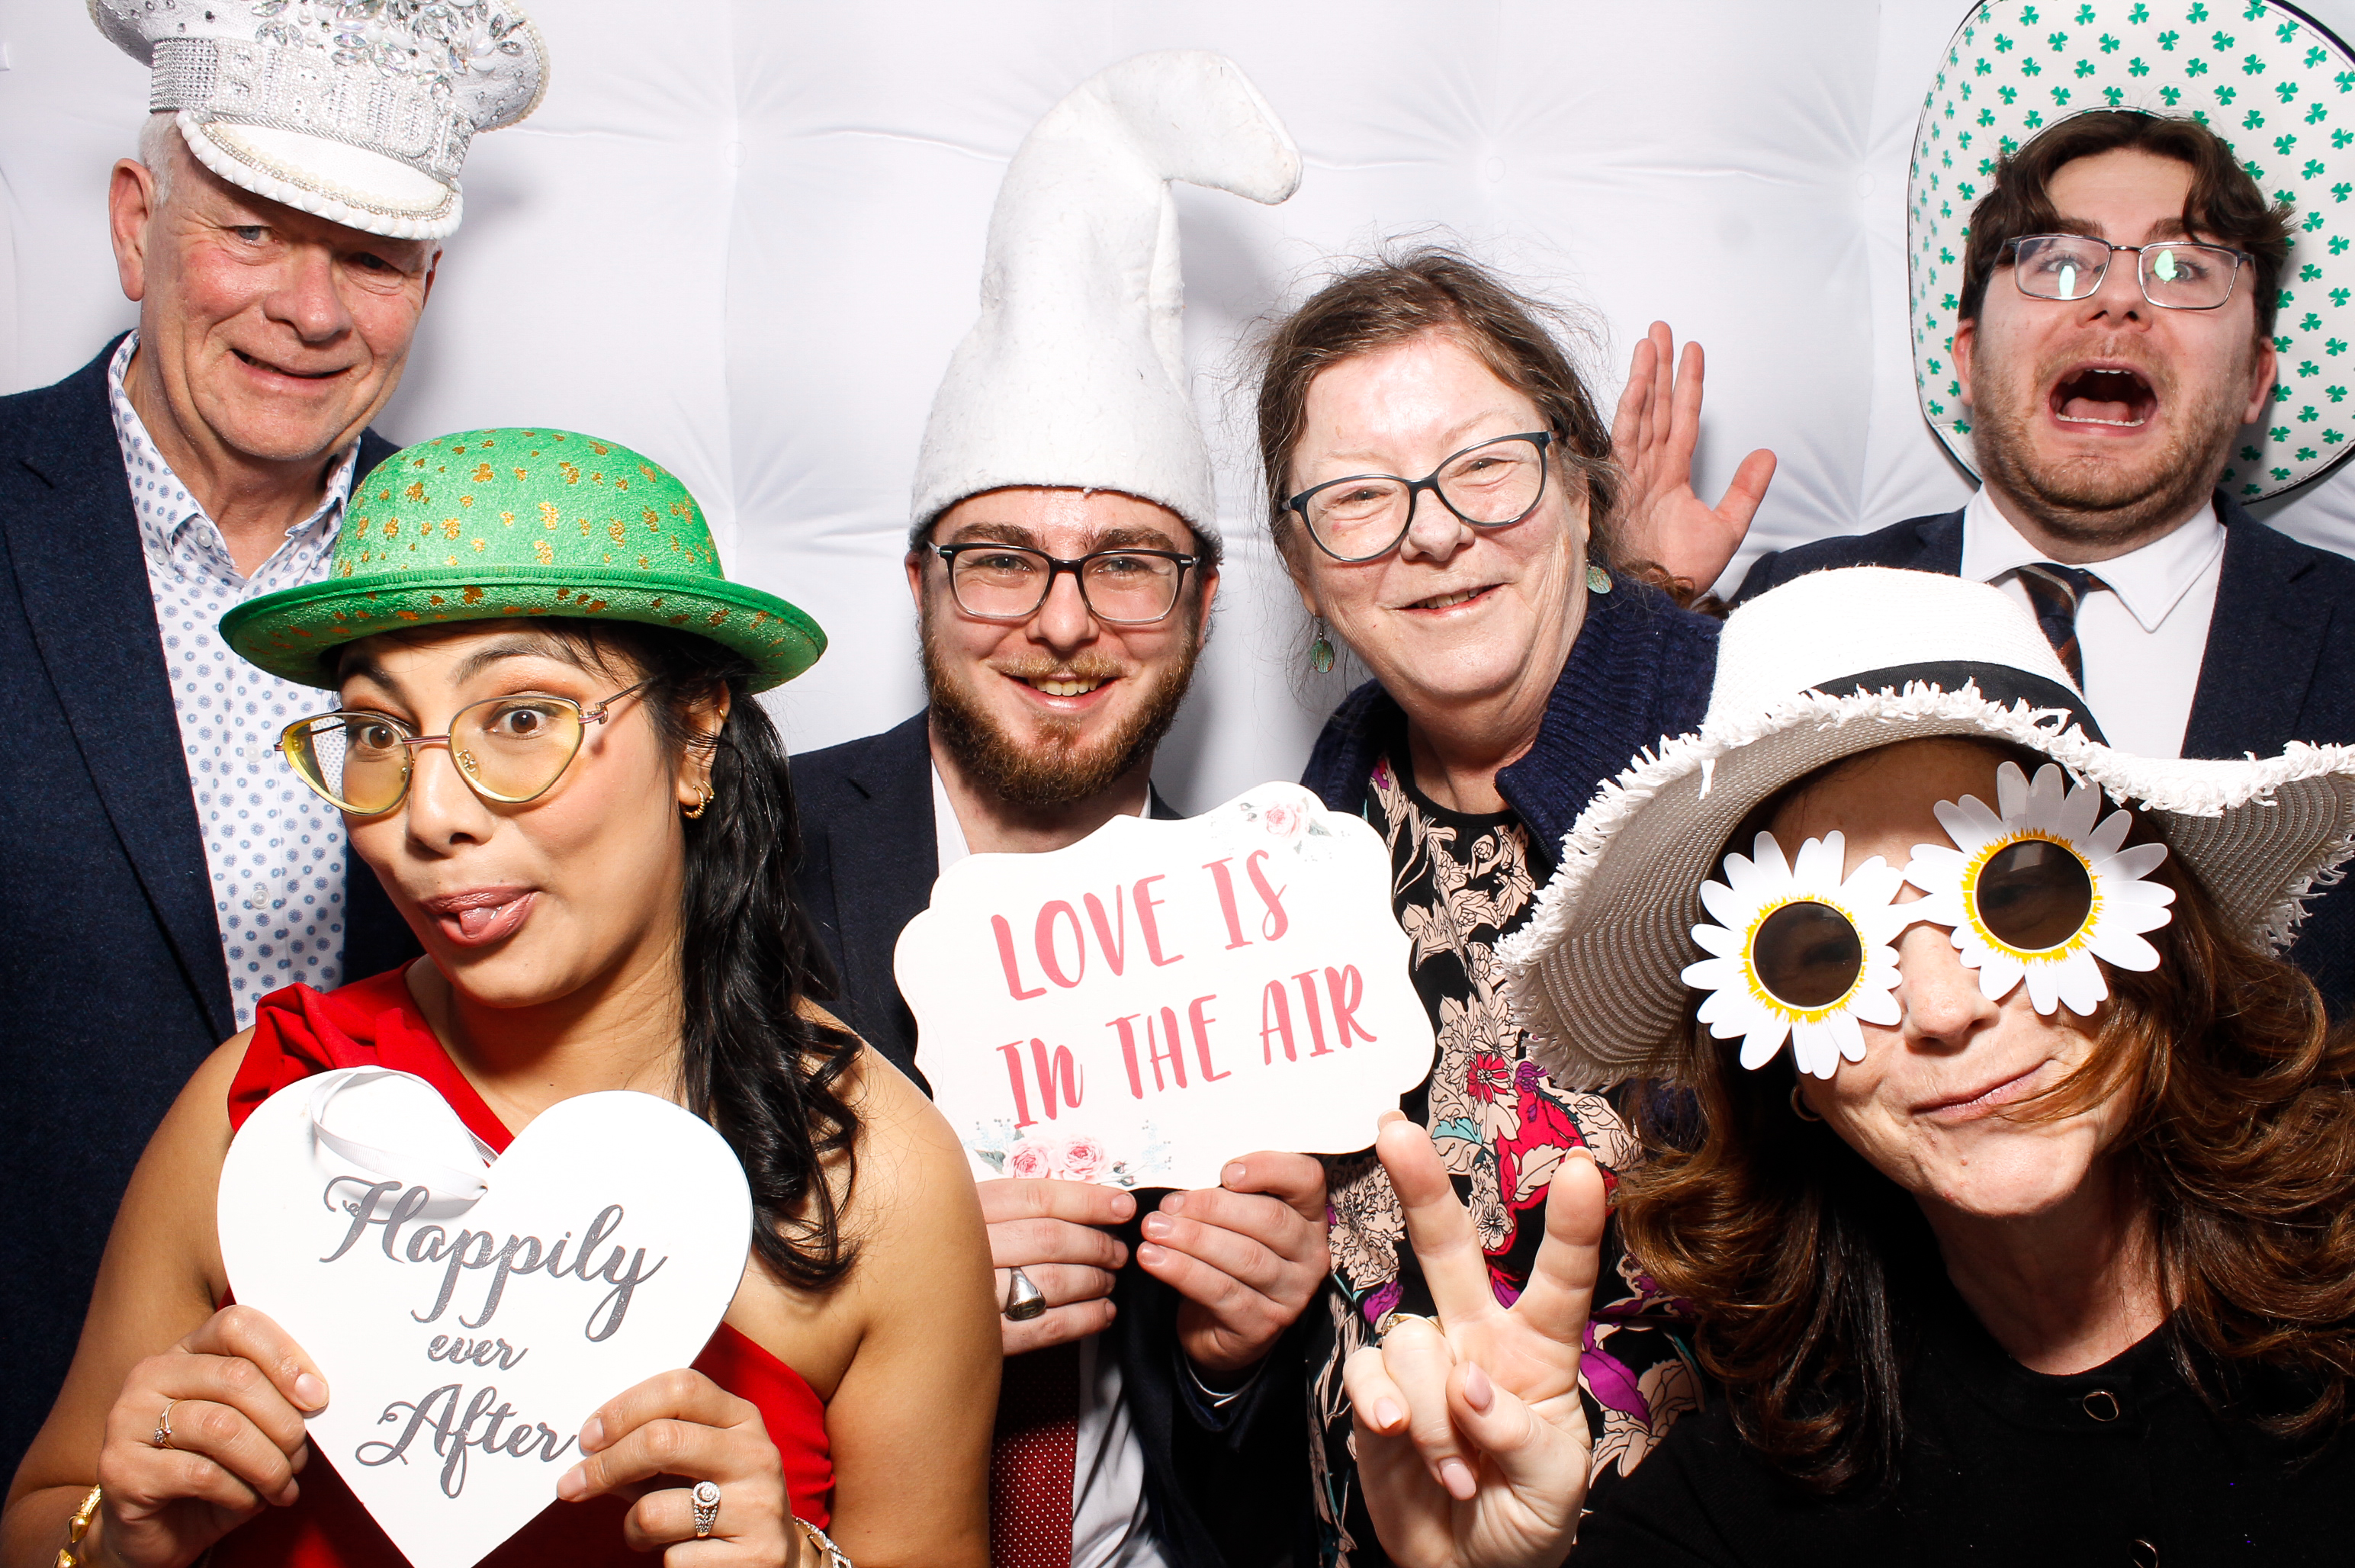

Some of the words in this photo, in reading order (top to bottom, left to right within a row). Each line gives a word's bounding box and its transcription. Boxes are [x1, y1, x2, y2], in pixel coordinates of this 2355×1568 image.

[210, 37, 474, 175] BRIDE
[991, 874, 1184, 1001] LOVE
[1202, 849, 1289, 951] IS
[1105, 994, 1232, 1100] THE
[1259, 964, 1377, 1066] AIR
[319, 1175, 669, 1343] Happily
[427, 1334, 529, 1371] ever
[355, 1383, 577, 1499] After
